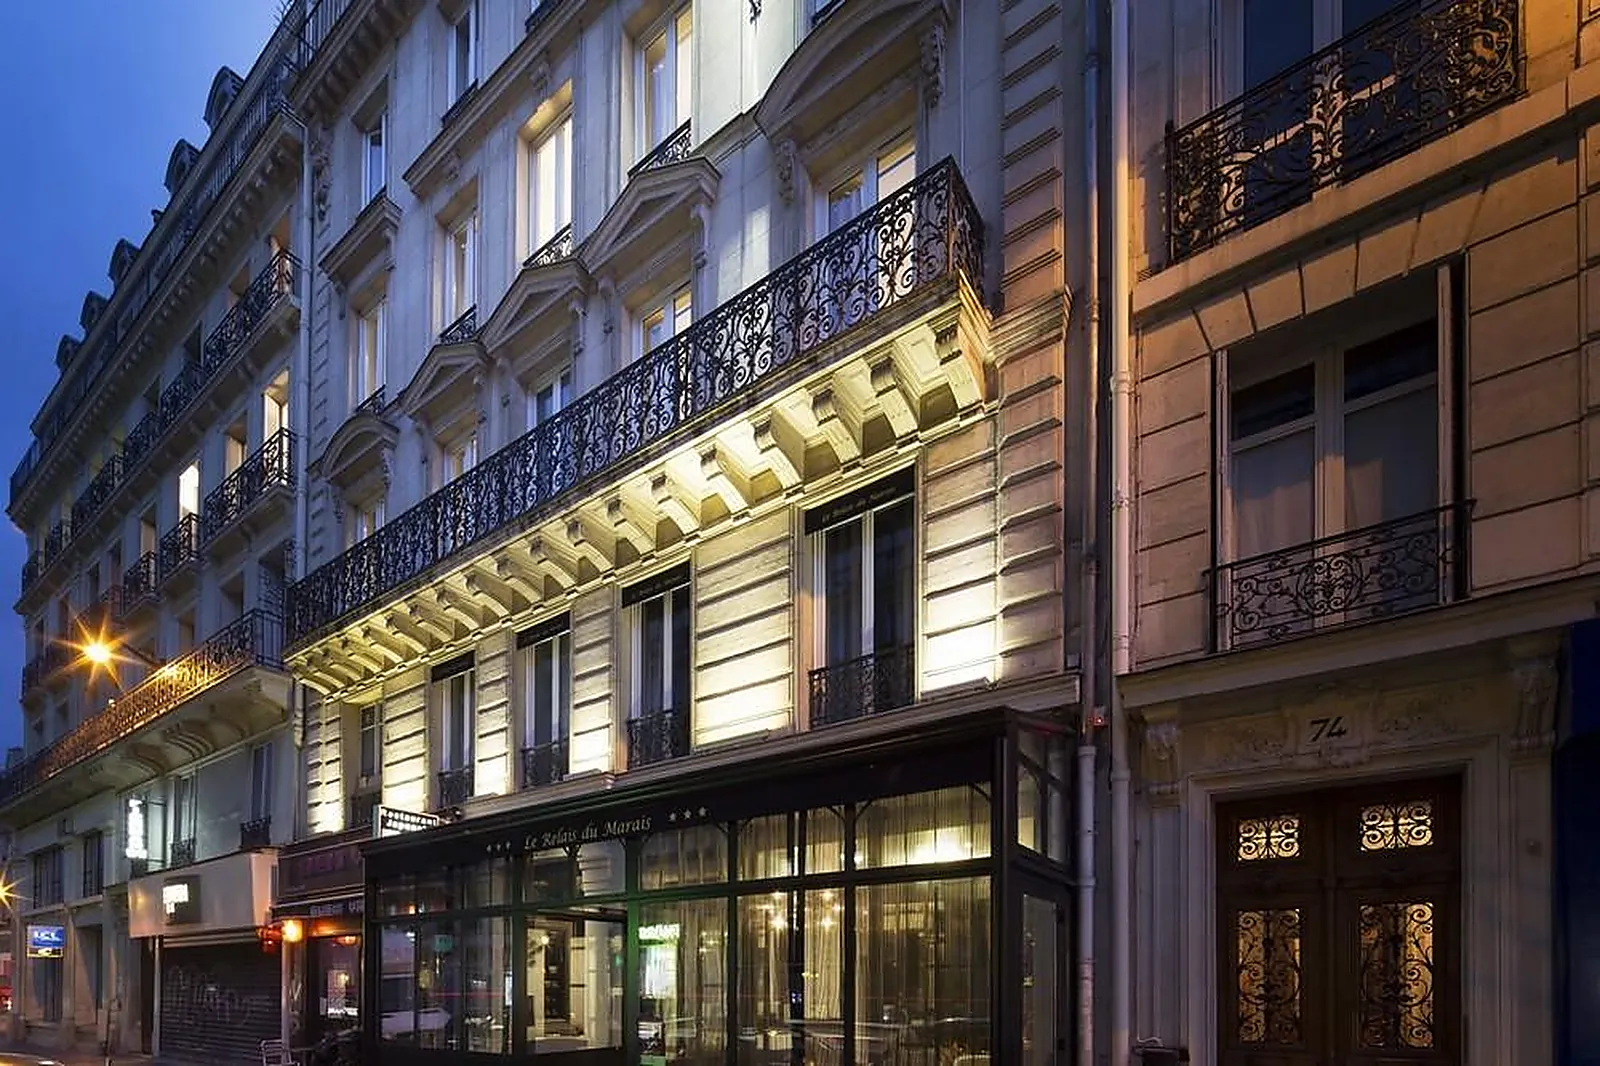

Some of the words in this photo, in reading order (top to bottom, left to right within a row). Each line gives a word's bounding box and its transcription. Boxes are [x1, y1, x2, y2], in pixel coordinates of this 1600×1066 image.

[1310, 716, 1347, 742] 74
[524, 834, 538, 850] Le
[540, 827, 578, 848] Relais
[581, 820, 598, 840] du
[602, 814, 652, 837] Marais
